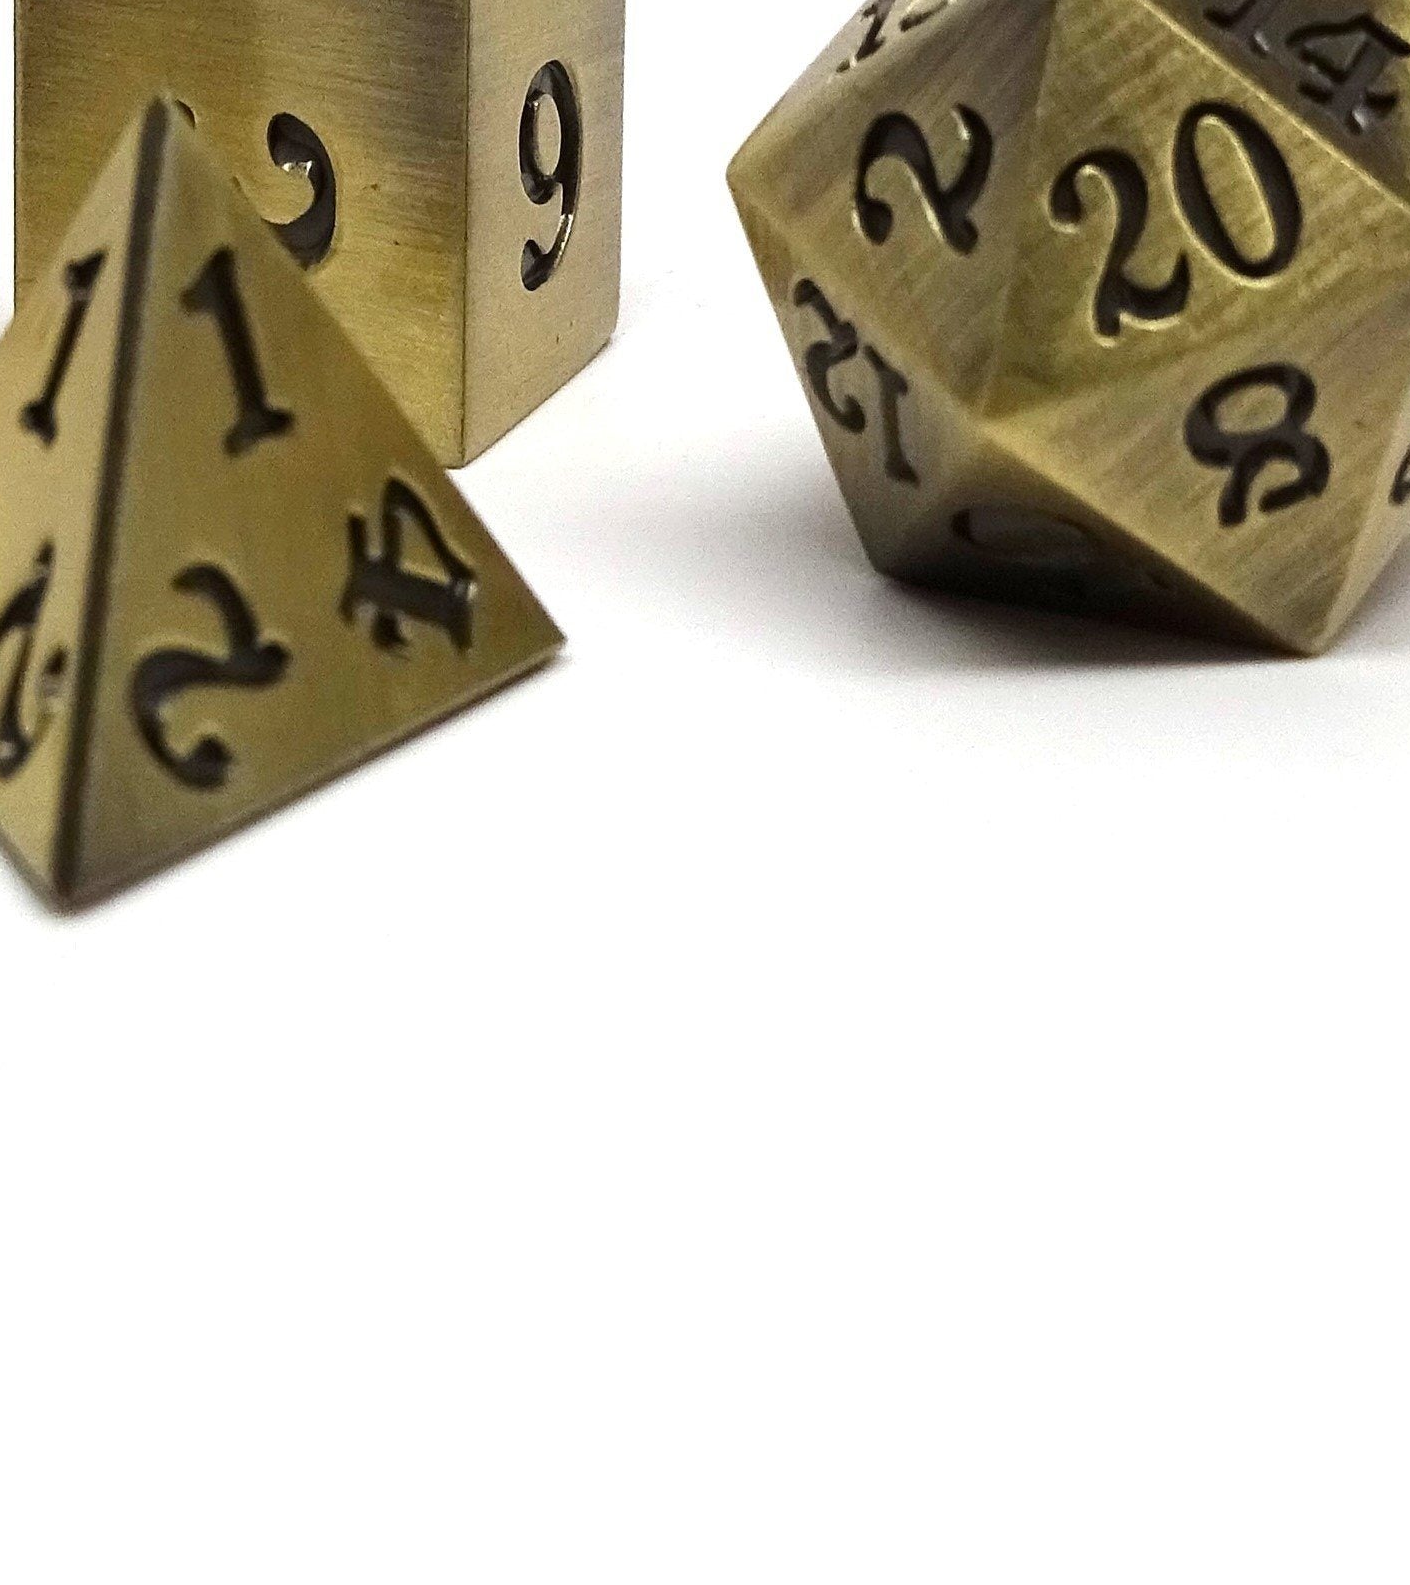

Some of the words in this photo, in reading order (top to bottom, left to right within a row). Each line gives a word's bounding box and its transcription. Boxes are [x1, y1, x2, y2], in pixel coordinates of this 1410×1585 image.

[852, 102, 993, 257] 2
[1048, 99, 1305, 344] 20
[19, 248, 108, 451] 1
[180, 244, 295, 458] 1
[793, 277, 922, 488] 12
[1183, 361, 1333, 529] 8
[339, 475, 480, 654] 4
[130, 561, 294, 791] 2
